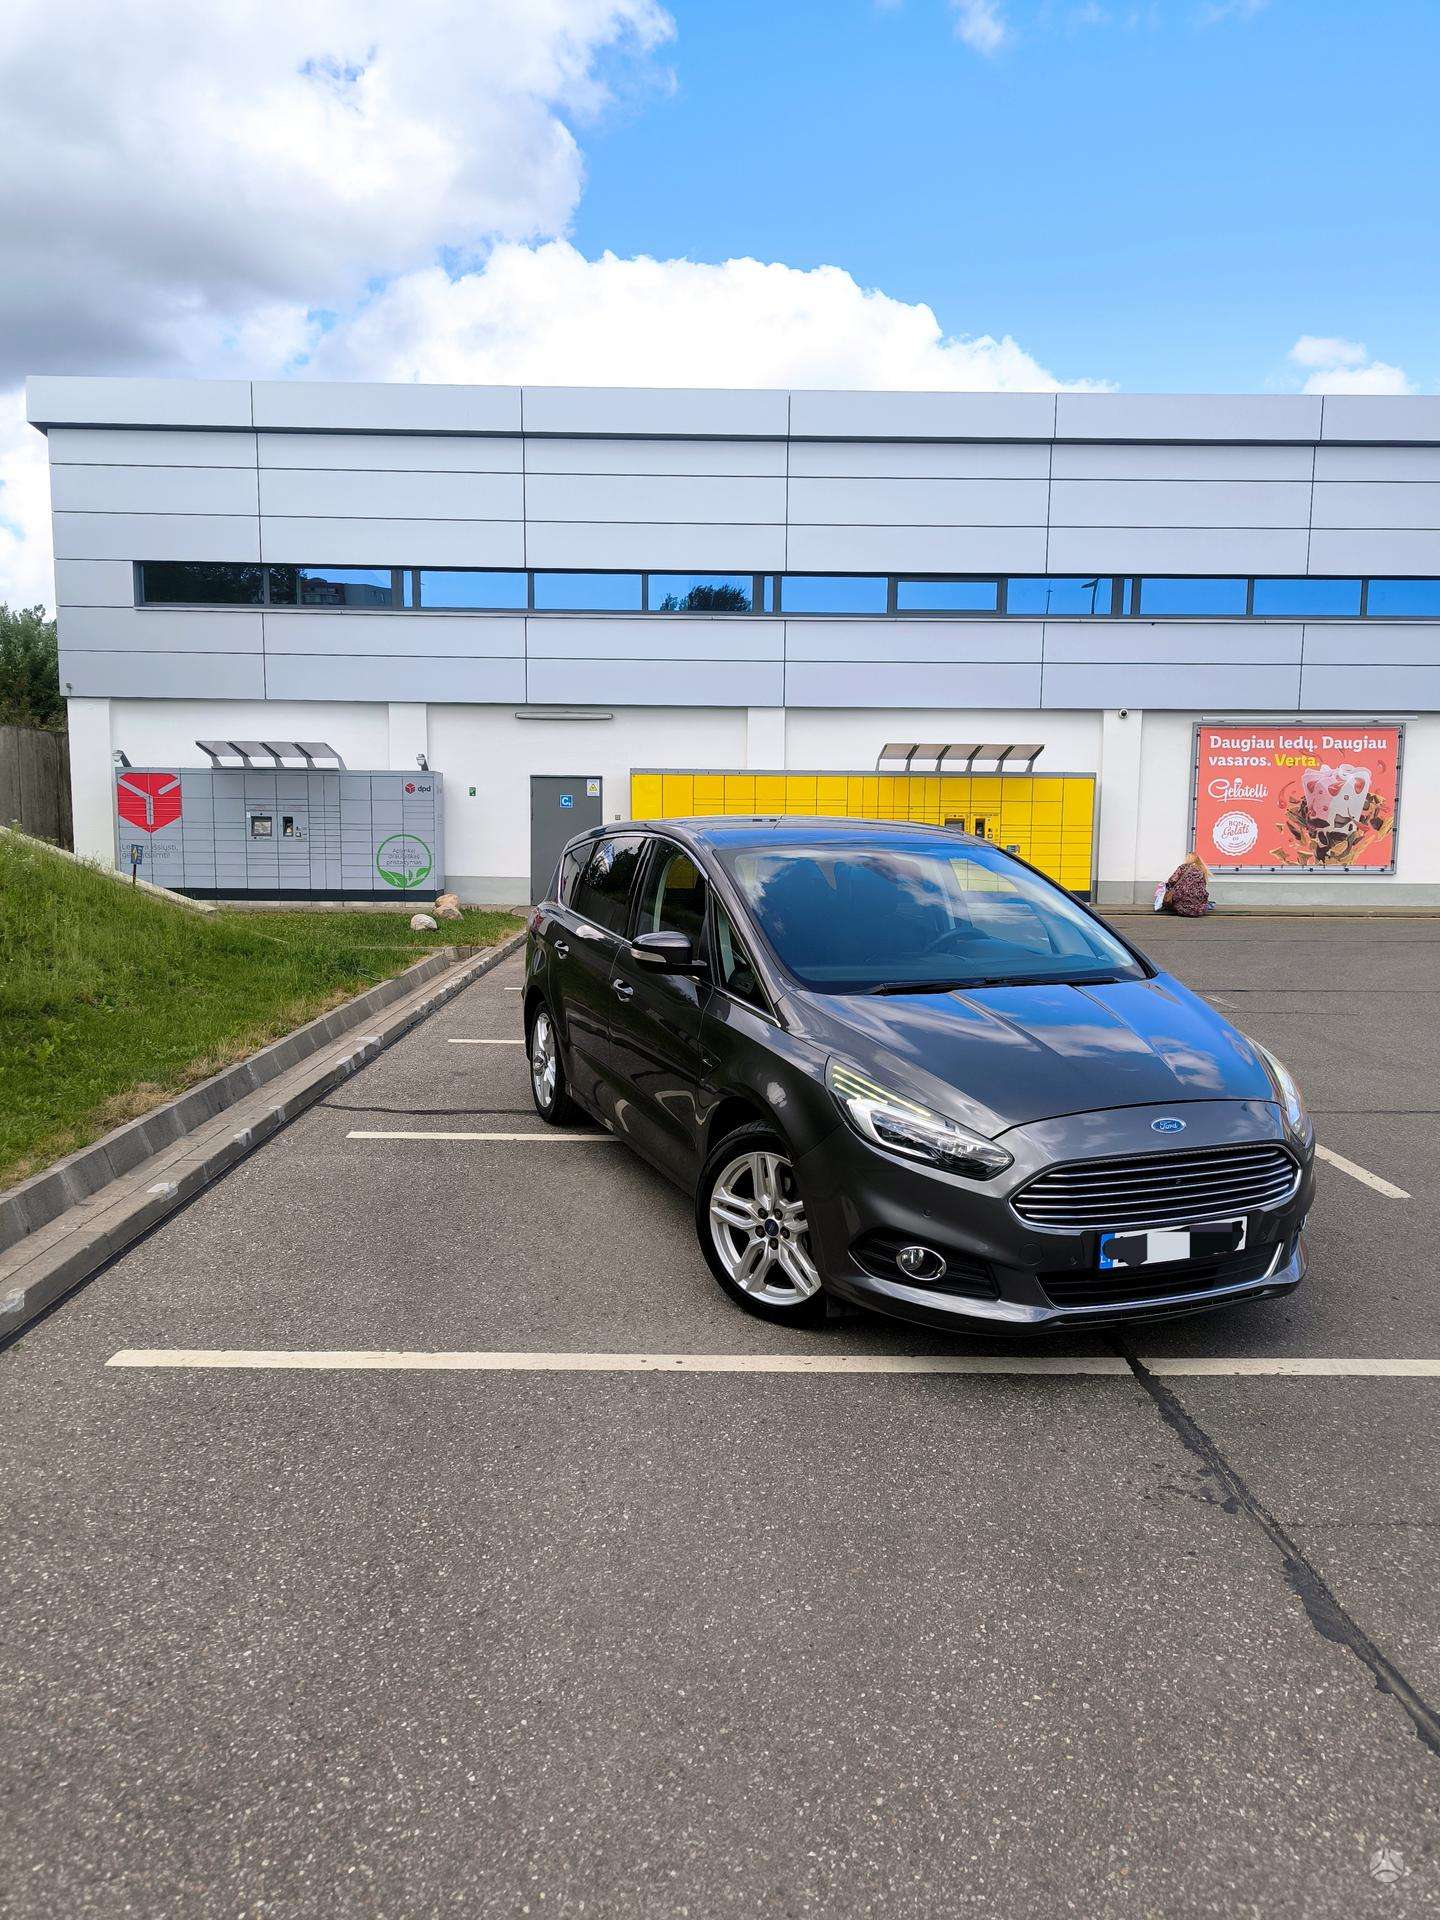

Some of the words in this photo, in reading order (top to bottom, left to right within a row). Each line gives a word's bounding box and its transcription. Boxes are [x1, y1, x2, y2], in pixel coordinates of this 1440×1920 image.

[1209, 735, 1275, 752] Daugiau
[1279, 735, 1318, 752] ledų.
[1321, 735, 1387, 752] Daugiau
[1208, 756, 1272, 767] vasaros.
[1274, 753, 1320, 767] Verta.
[417, 785, 431, 793] dpd
[1208, 778, 1268, 802] Gelatelli
